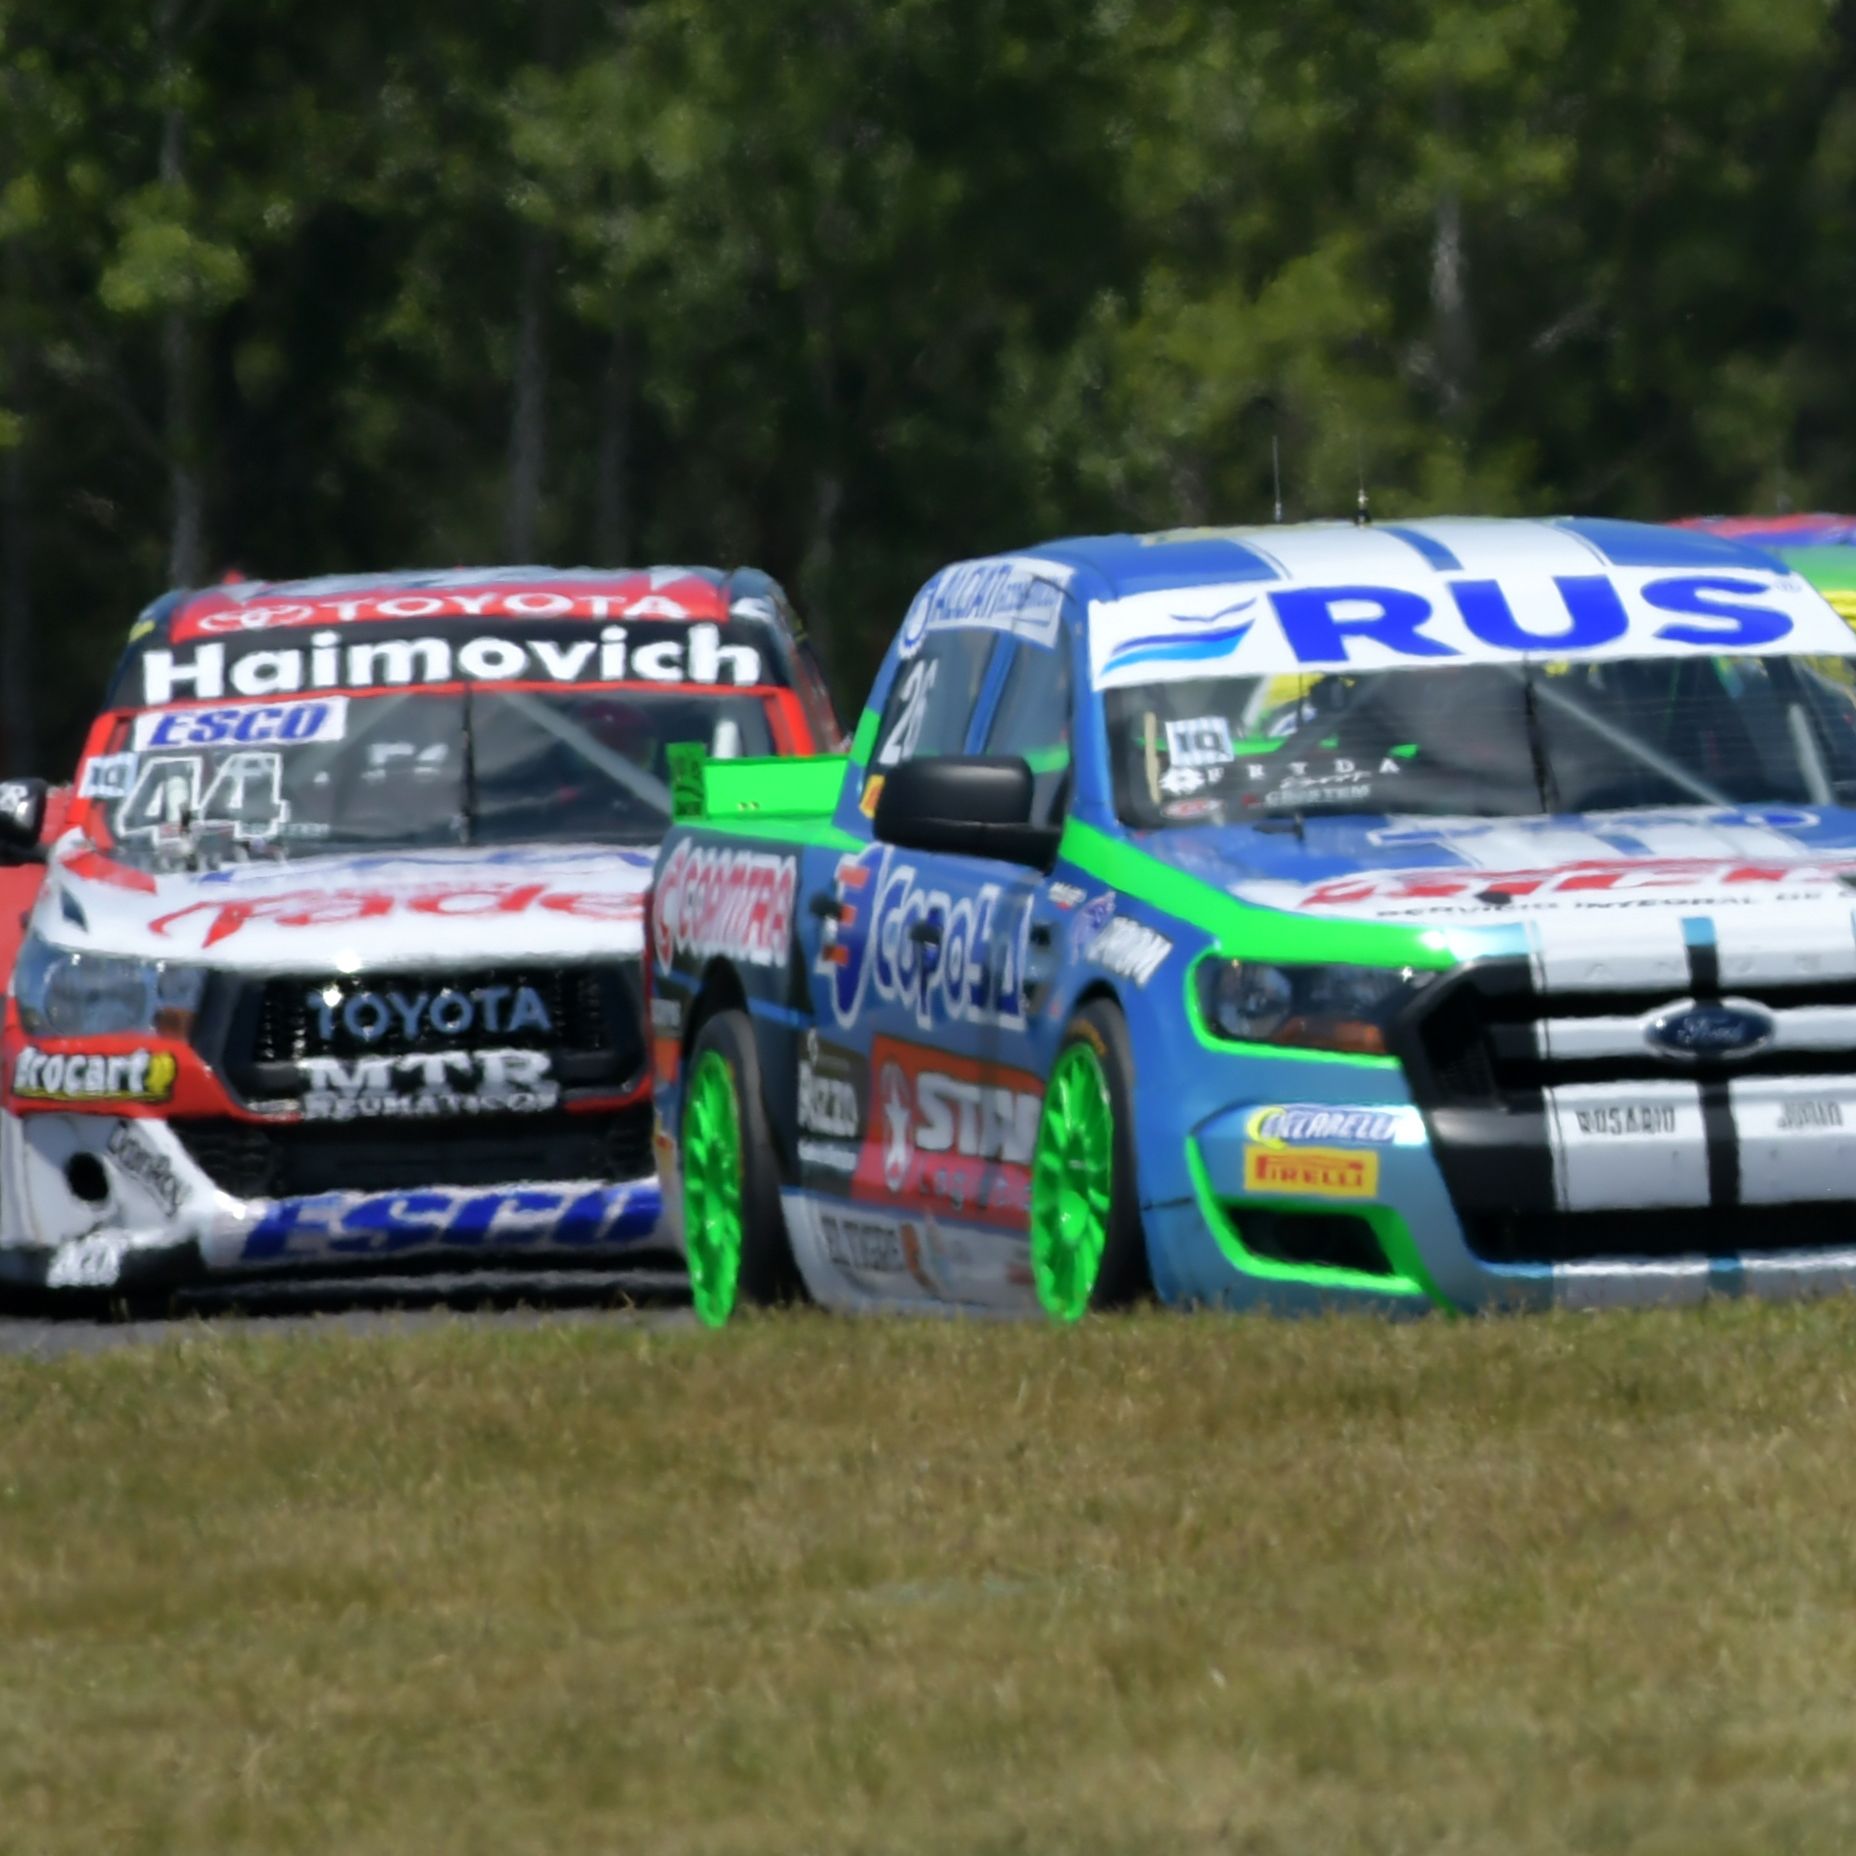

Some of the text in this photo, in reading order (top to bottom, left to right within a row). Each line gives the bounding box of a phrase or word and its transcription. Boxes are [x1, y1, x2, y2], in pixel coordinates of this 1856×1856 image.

[319, 590, 690, 621] TOYOTA
[1266, 574, 1796, 663] RUS
[142, 625, 762, 705] Haimovich
[149, 701, 330, 746] ESCO
[116, 752, 290, 846] 44
[305, 986, 553, 1042] TOYOTA
[297, 1048, 558, 1099] MTR
[1256, 1153, 1366, 1188] PIRELLI
